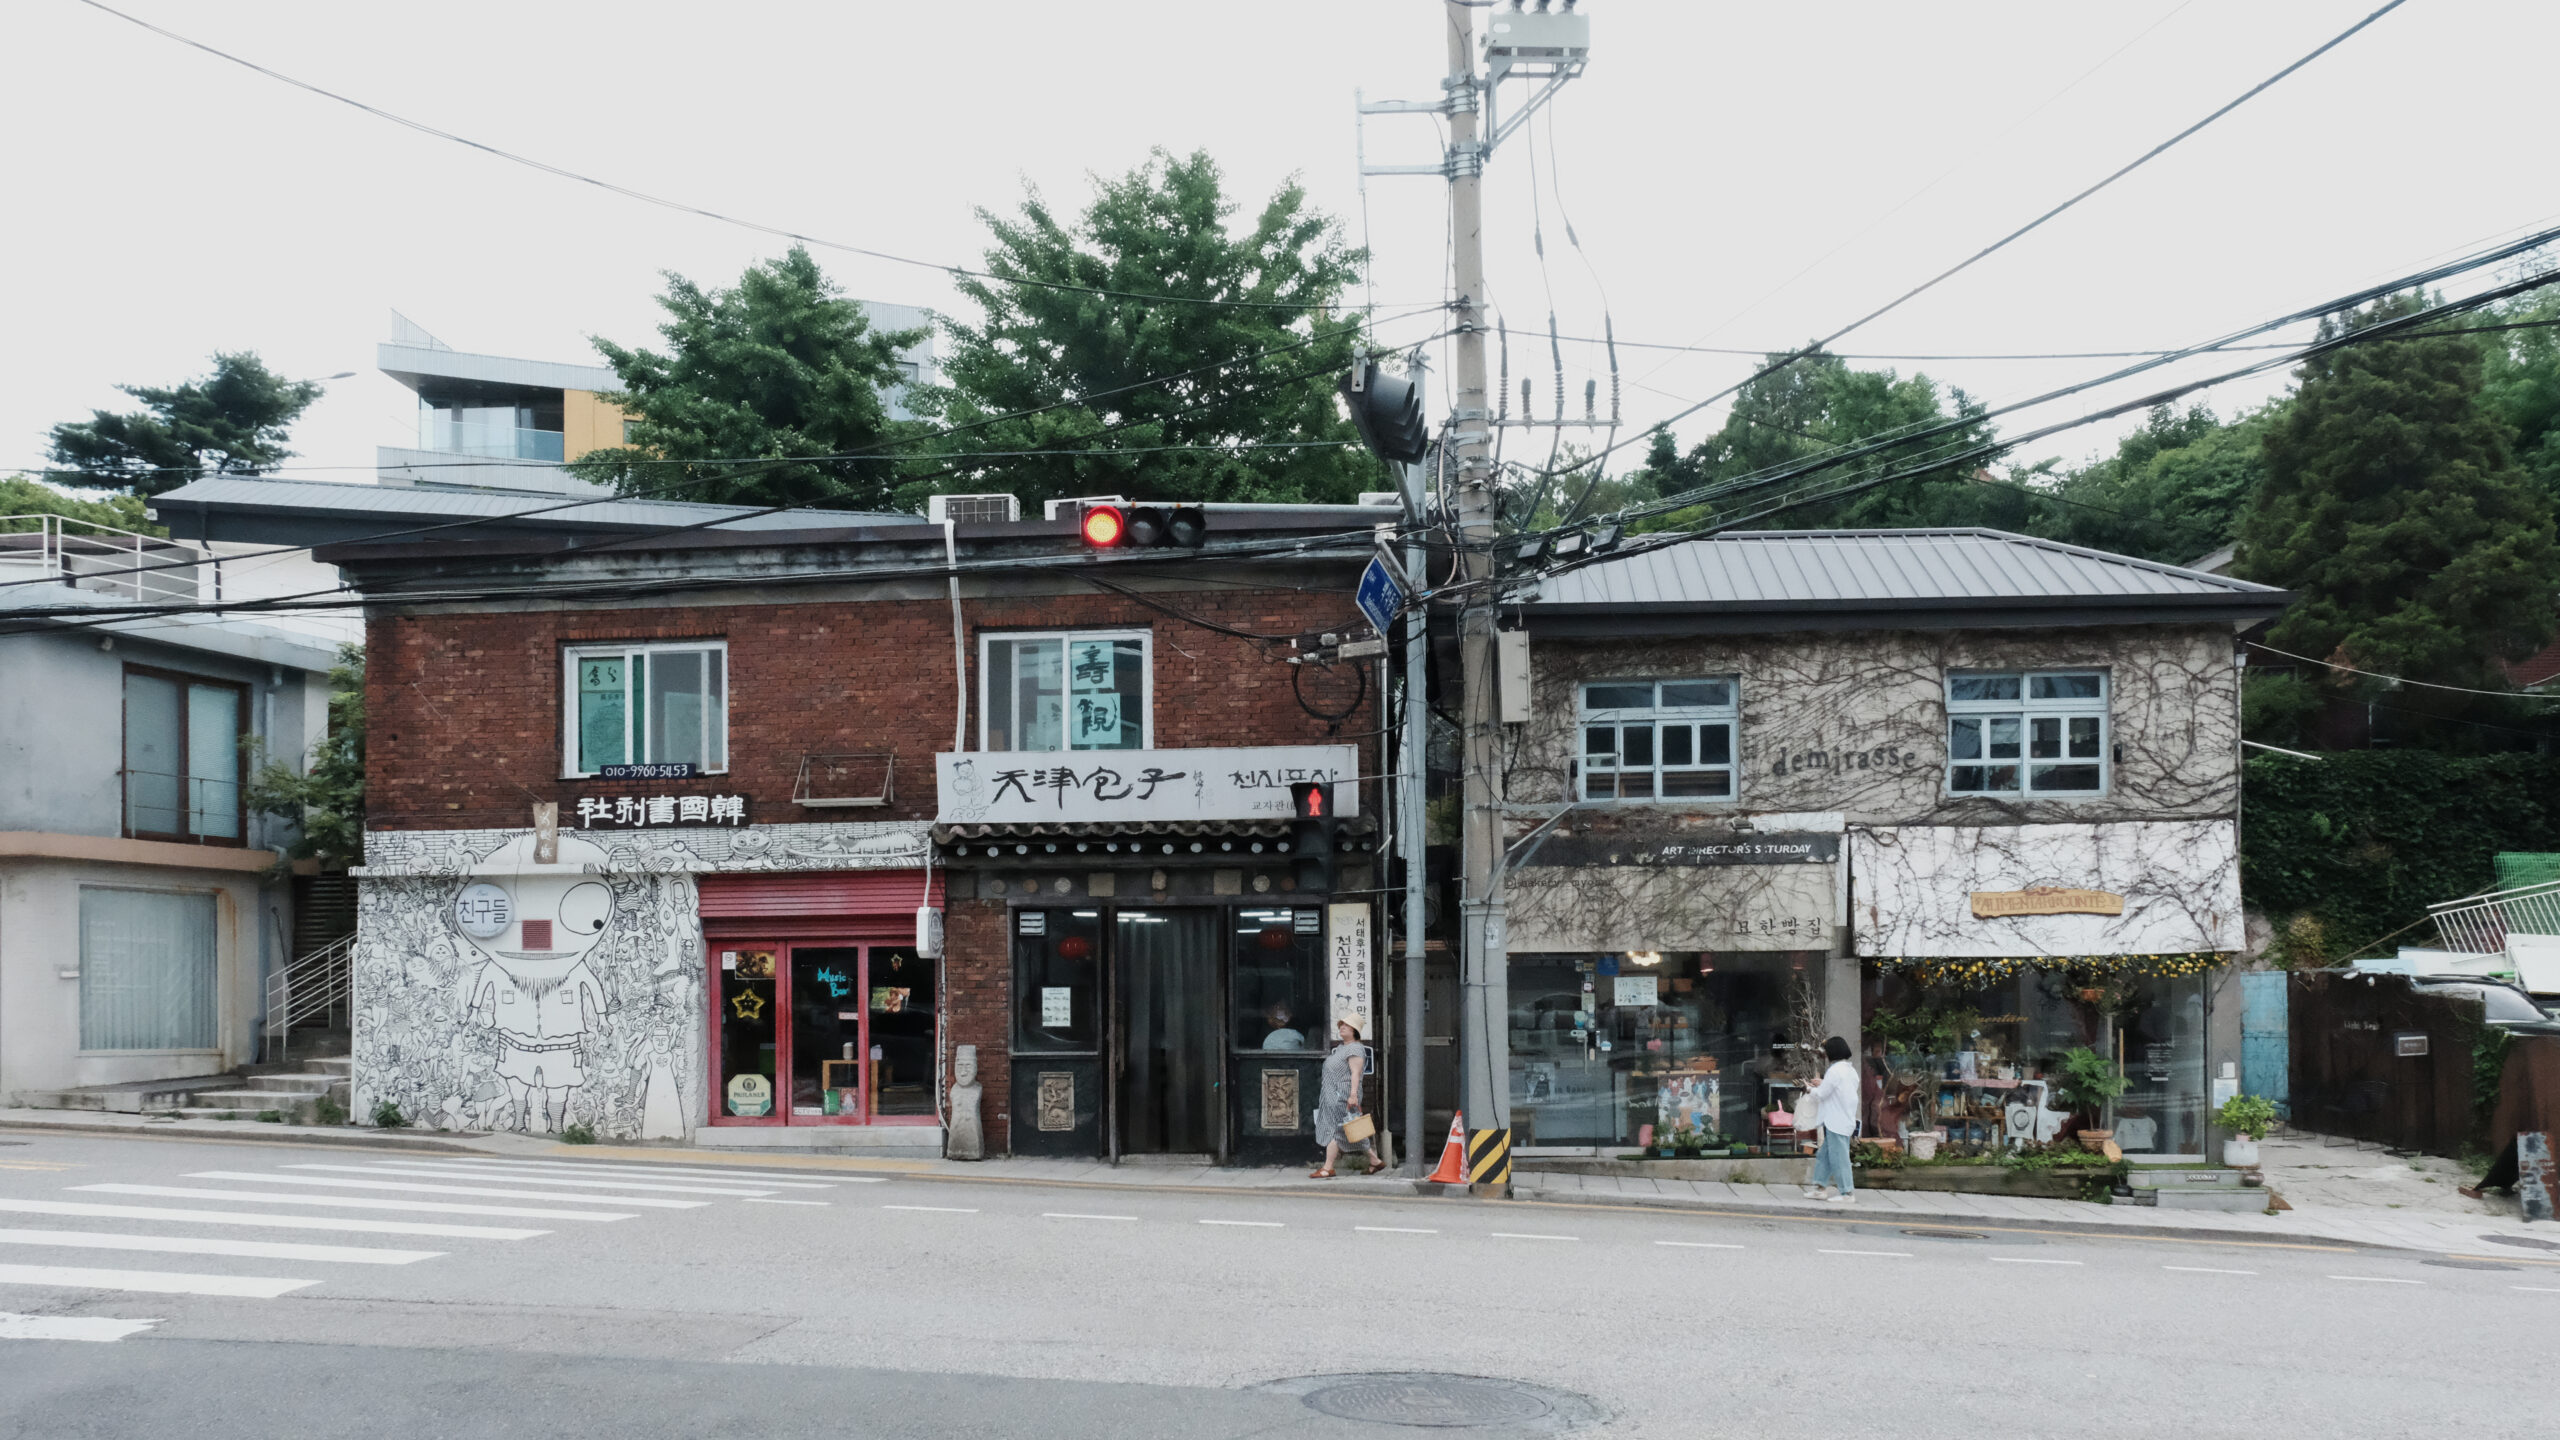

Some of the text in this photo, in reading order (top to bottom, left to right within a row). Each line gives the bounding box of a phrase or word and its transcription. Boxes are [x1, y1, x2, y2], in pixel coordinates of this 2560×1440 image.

[605, 764, 688, 778] 010-9960-5453
[1662, 846, 1684, 856] ART
[459, 899, 508, 924] 친구들
[817, 966, 847, 982] Music
[830, 982, 849, 998] Bar
